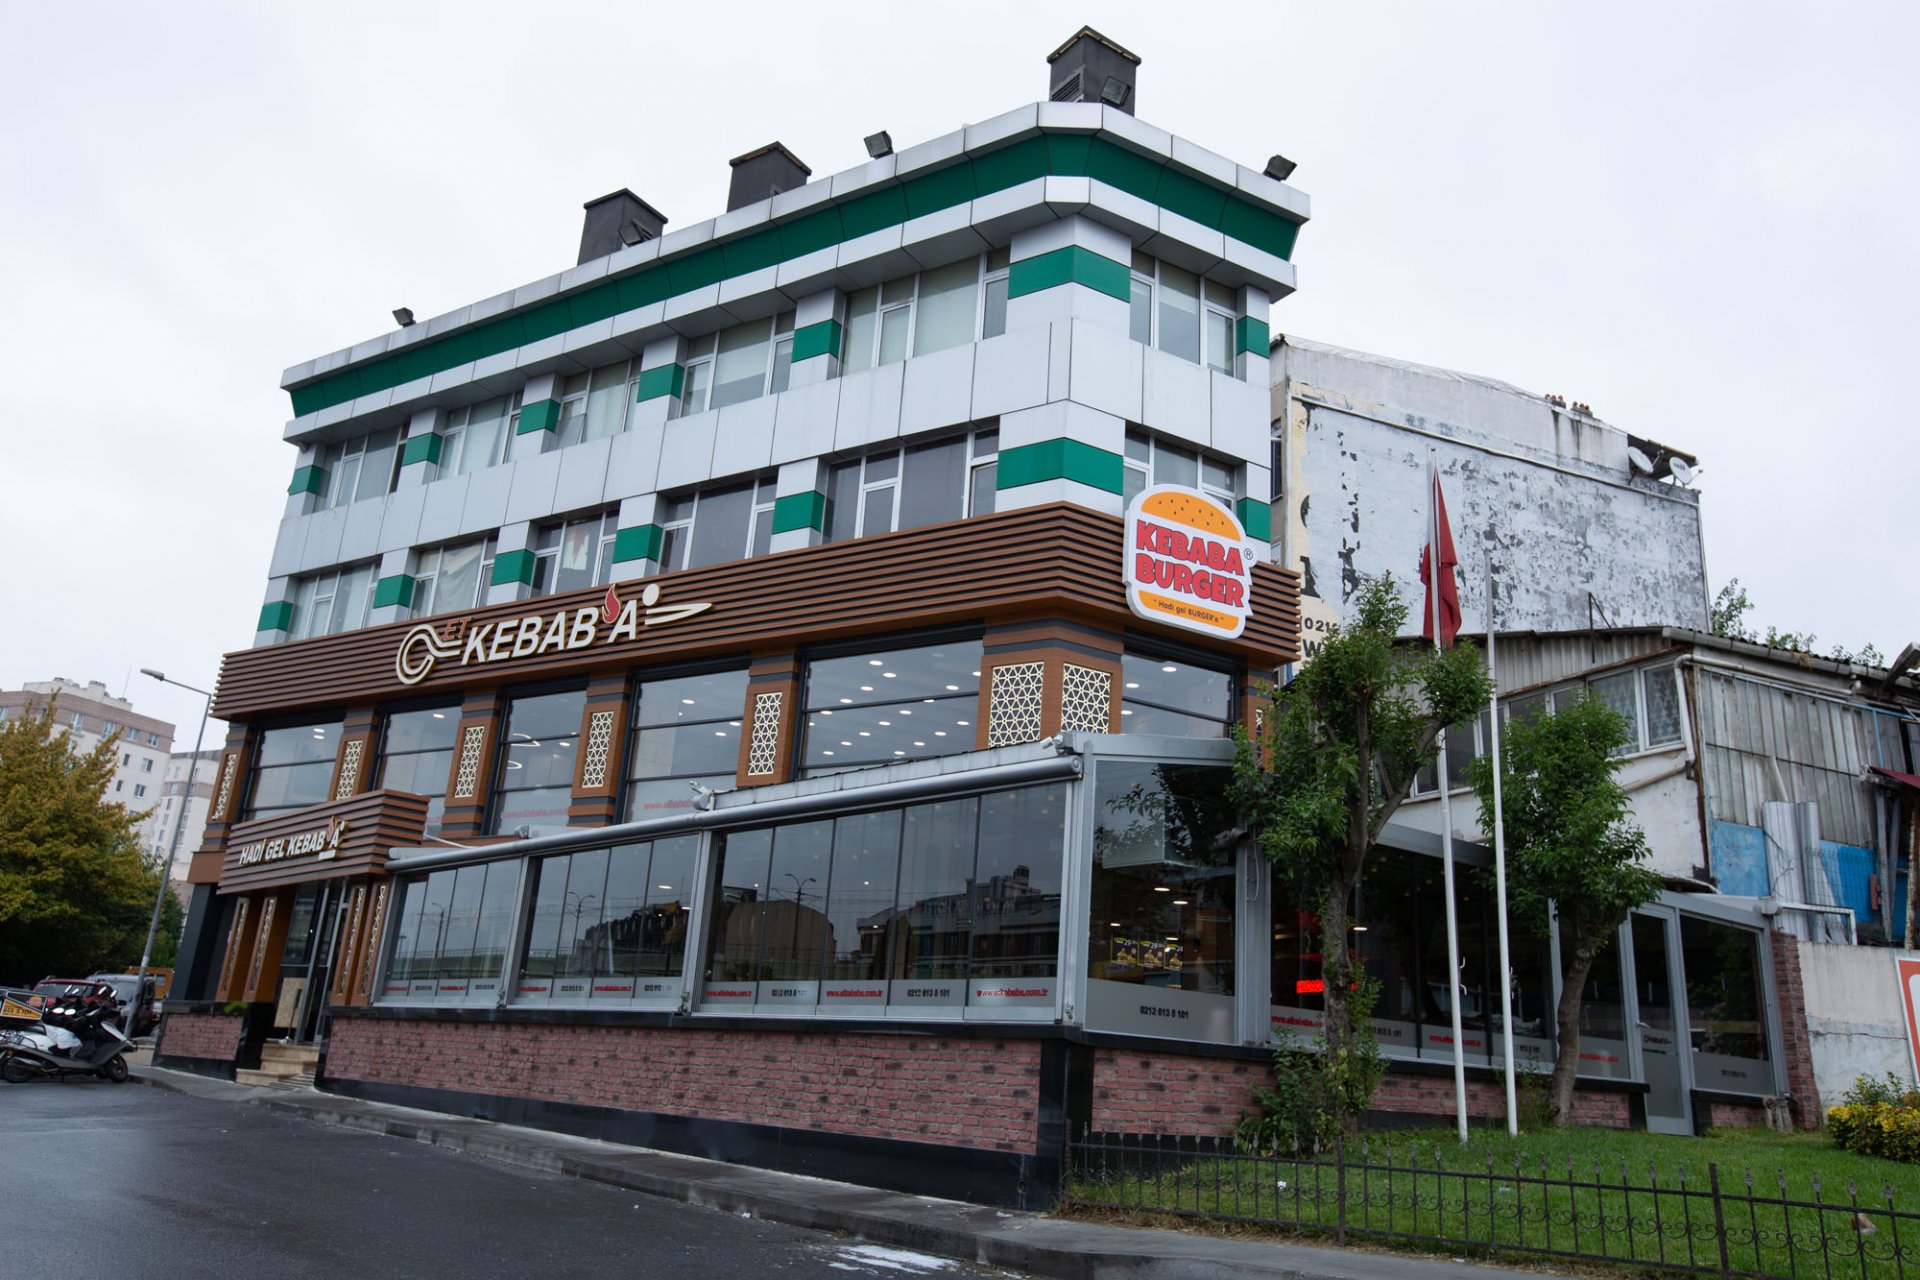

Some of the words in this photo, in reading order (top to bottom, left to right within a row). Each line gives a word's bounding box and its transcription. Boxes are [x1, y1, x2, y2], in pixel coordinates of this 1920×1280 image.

[1136, 519, 1244, 576] KEBABA
[1136, 553, 1244, 607] BURGER
[443, 616, 472, 640] ET
[265, 839, 286, 860] GEL
[1140, 1005, 1156, 1016] 0212
